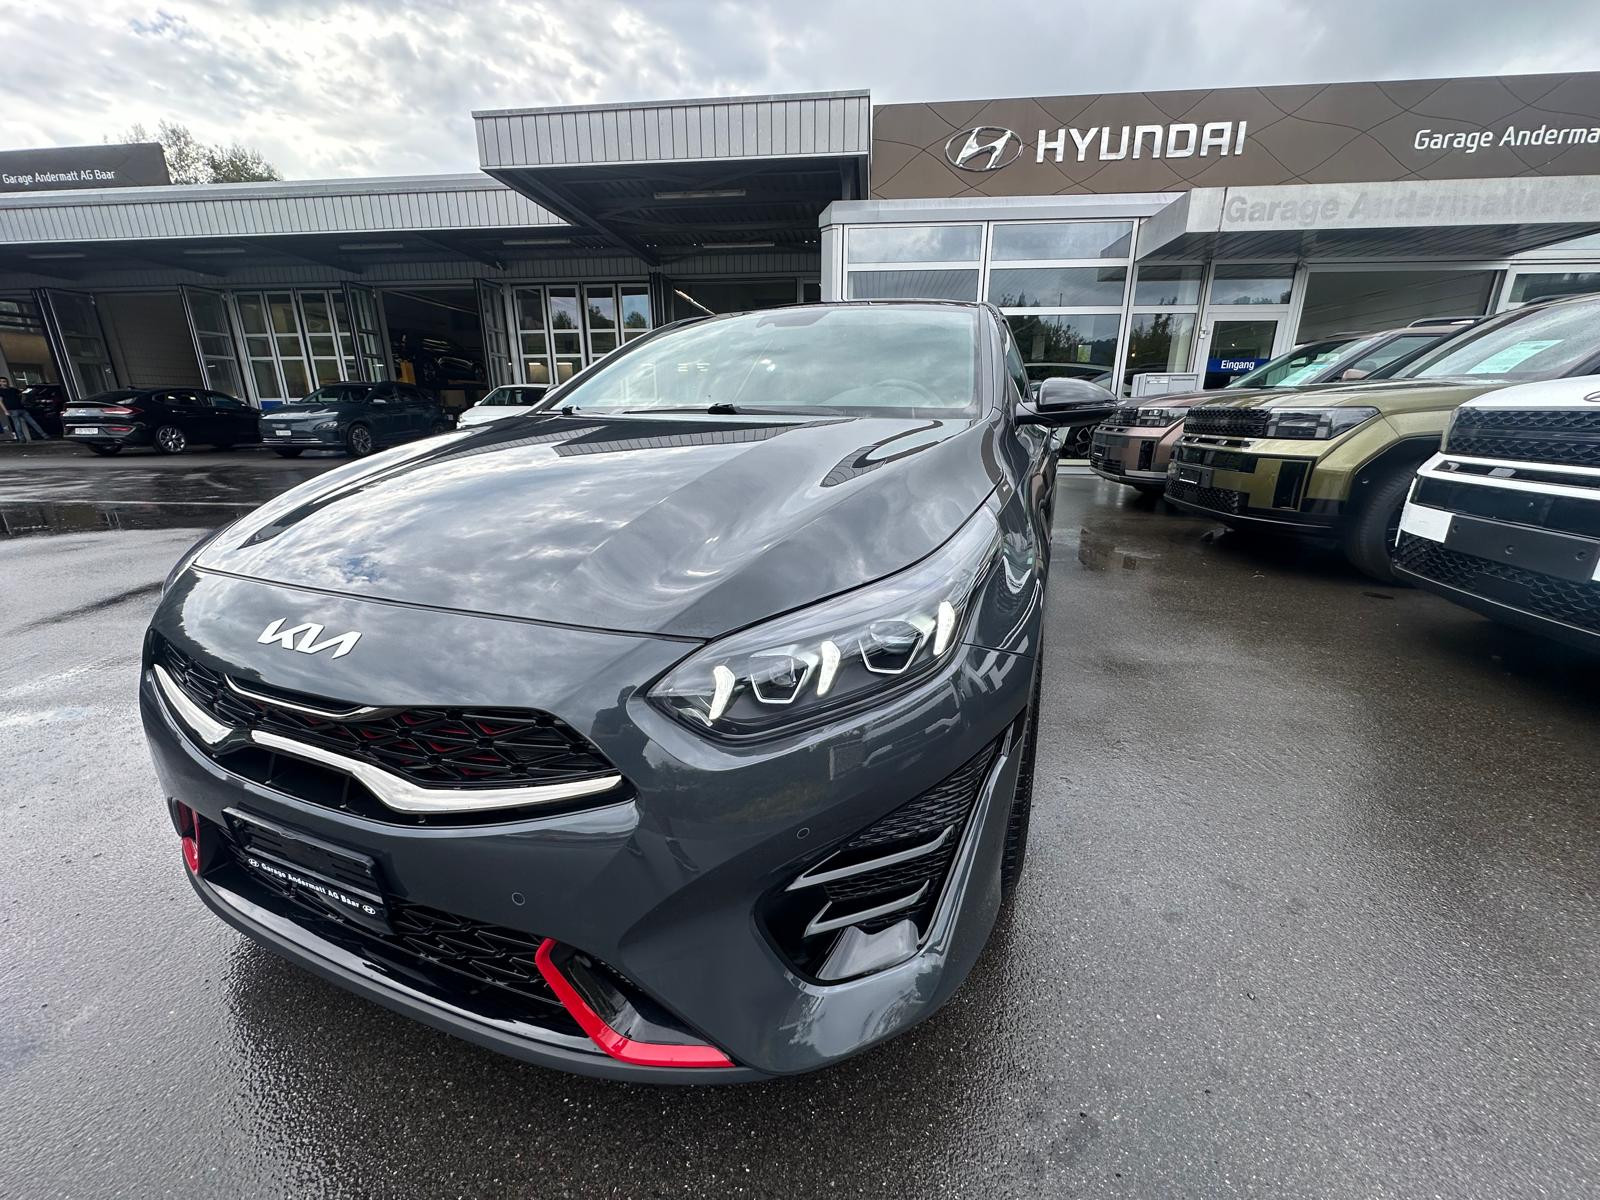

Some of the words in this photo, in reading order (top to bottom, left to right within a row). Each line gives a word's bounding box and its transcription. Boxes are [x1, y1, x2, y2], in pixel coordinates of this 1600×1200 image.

[1036, 121, 1247, 163] HYUNDAI
[1414, 129, 1493, 153] Garage
[1498, 124, 1600, 147] Anderma
[2, 173, 33, 186] Garage
[35, 170, 78, 183] Andermatt
[80, 169, 93, 181] AG
[95, 169, 116, 180] Baar
[1225, 195, 1340, 227] Garage
[1220, 360, 1255, 371] Eingang
[257, 617, 362, 659] KIA
[261, 862, 286, 879] Garage
[287, 873, 327, 895] Andermatt
[327, 889, 340, 900] AG
[340, 894, 360, 909] Baar
